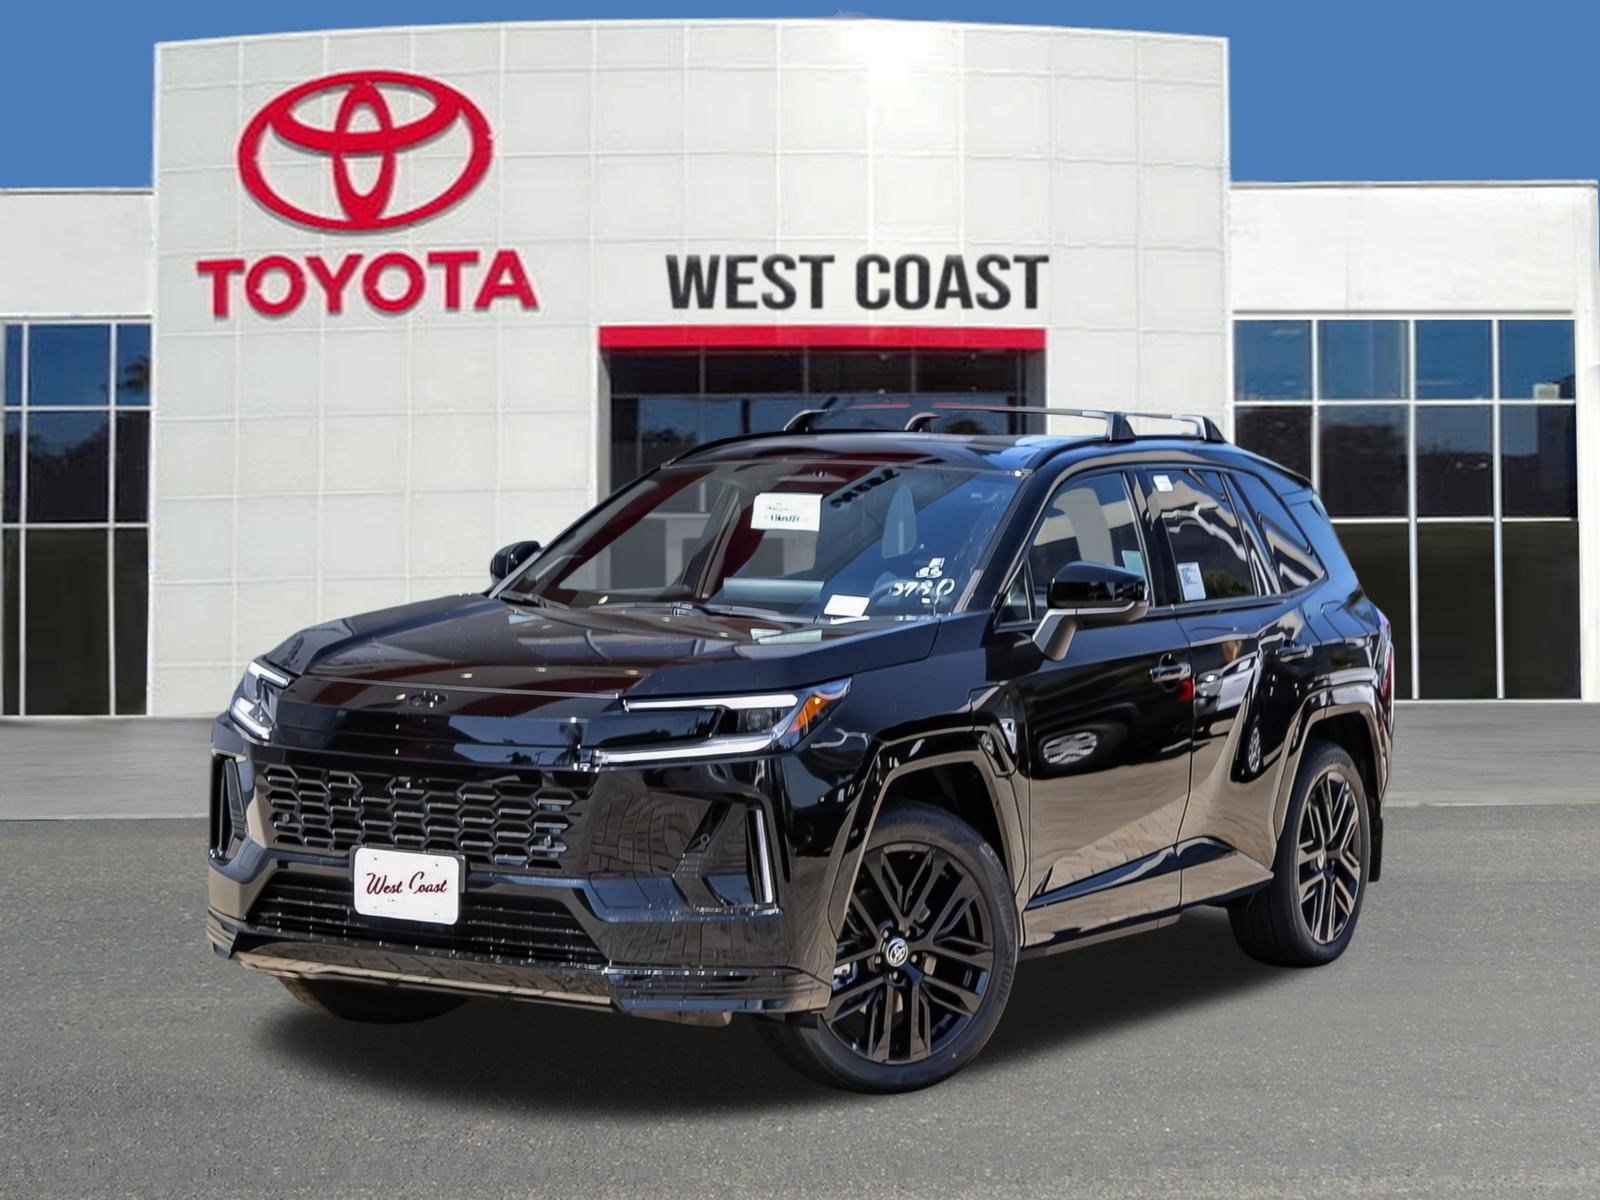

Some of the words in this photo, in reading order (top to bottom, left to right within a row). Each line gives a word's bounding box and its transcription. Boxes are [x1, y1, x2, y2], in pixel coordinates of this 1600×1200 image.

[196, 249, 539, 318] TOYOTA
[665, 254, 835, 310] WEST
[855, 254, 1050, 310] COAST
[366, 872, 403, 895] West
[408, 871, 448, 895] Coast
